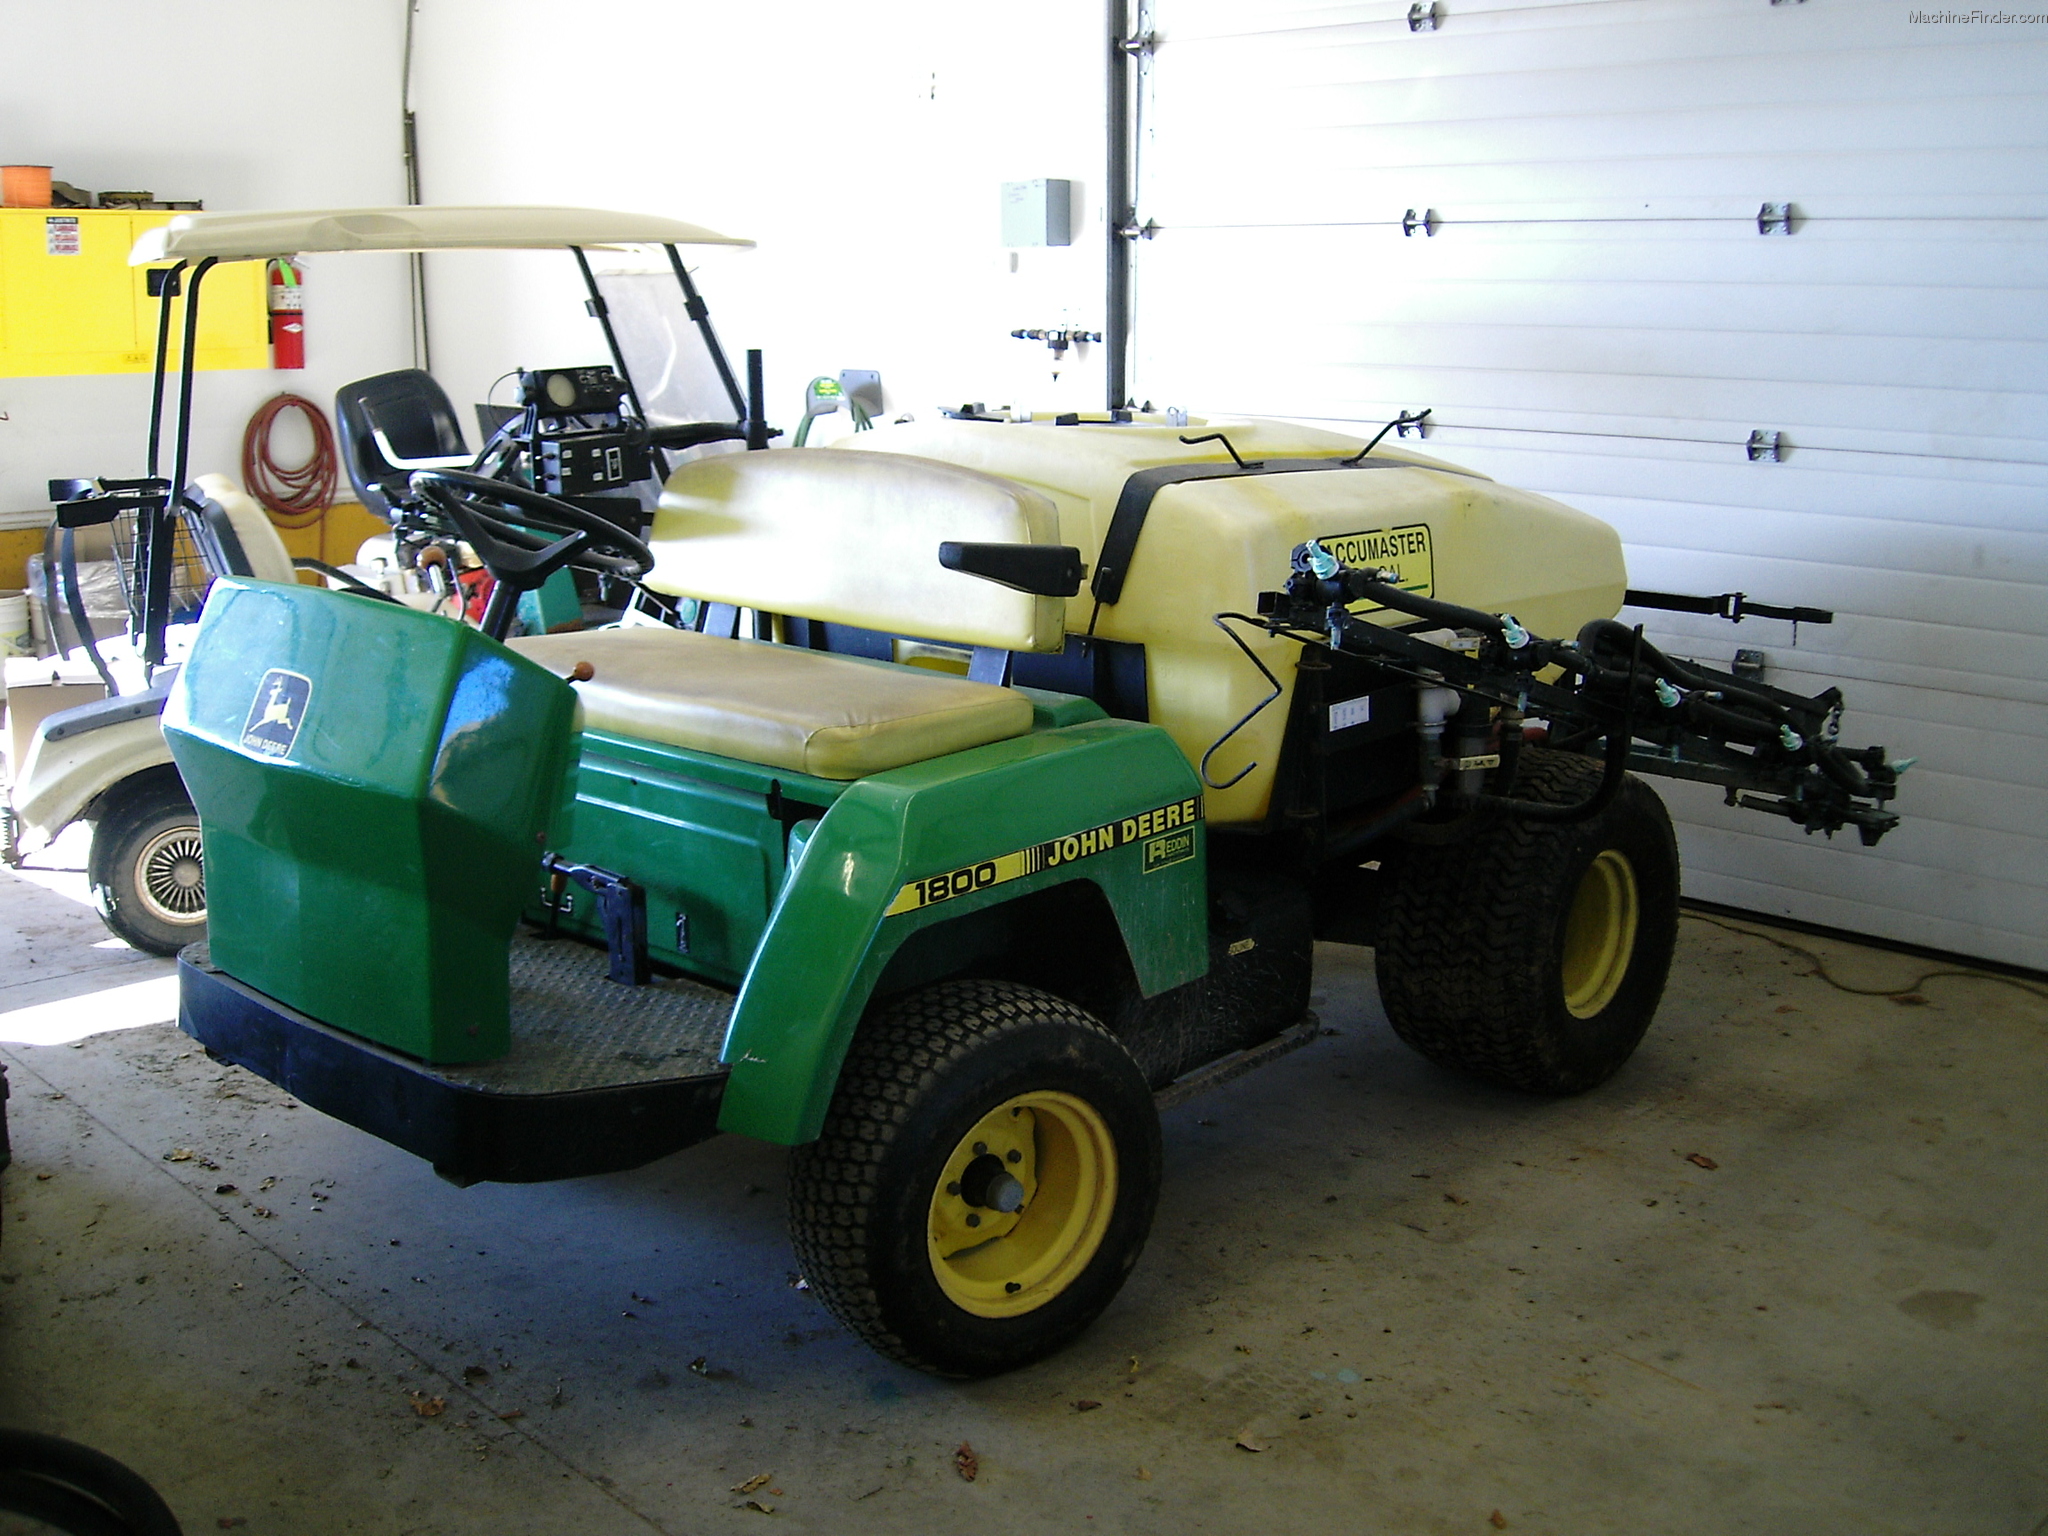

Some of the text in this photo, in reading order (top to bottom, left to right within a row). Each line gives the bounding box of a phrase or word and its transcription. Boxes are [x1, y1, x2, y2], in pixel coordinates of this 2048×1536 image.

[1048, 798, 1195, 867] JOHN DEERE
[914, 863, 996, 905] 1800
